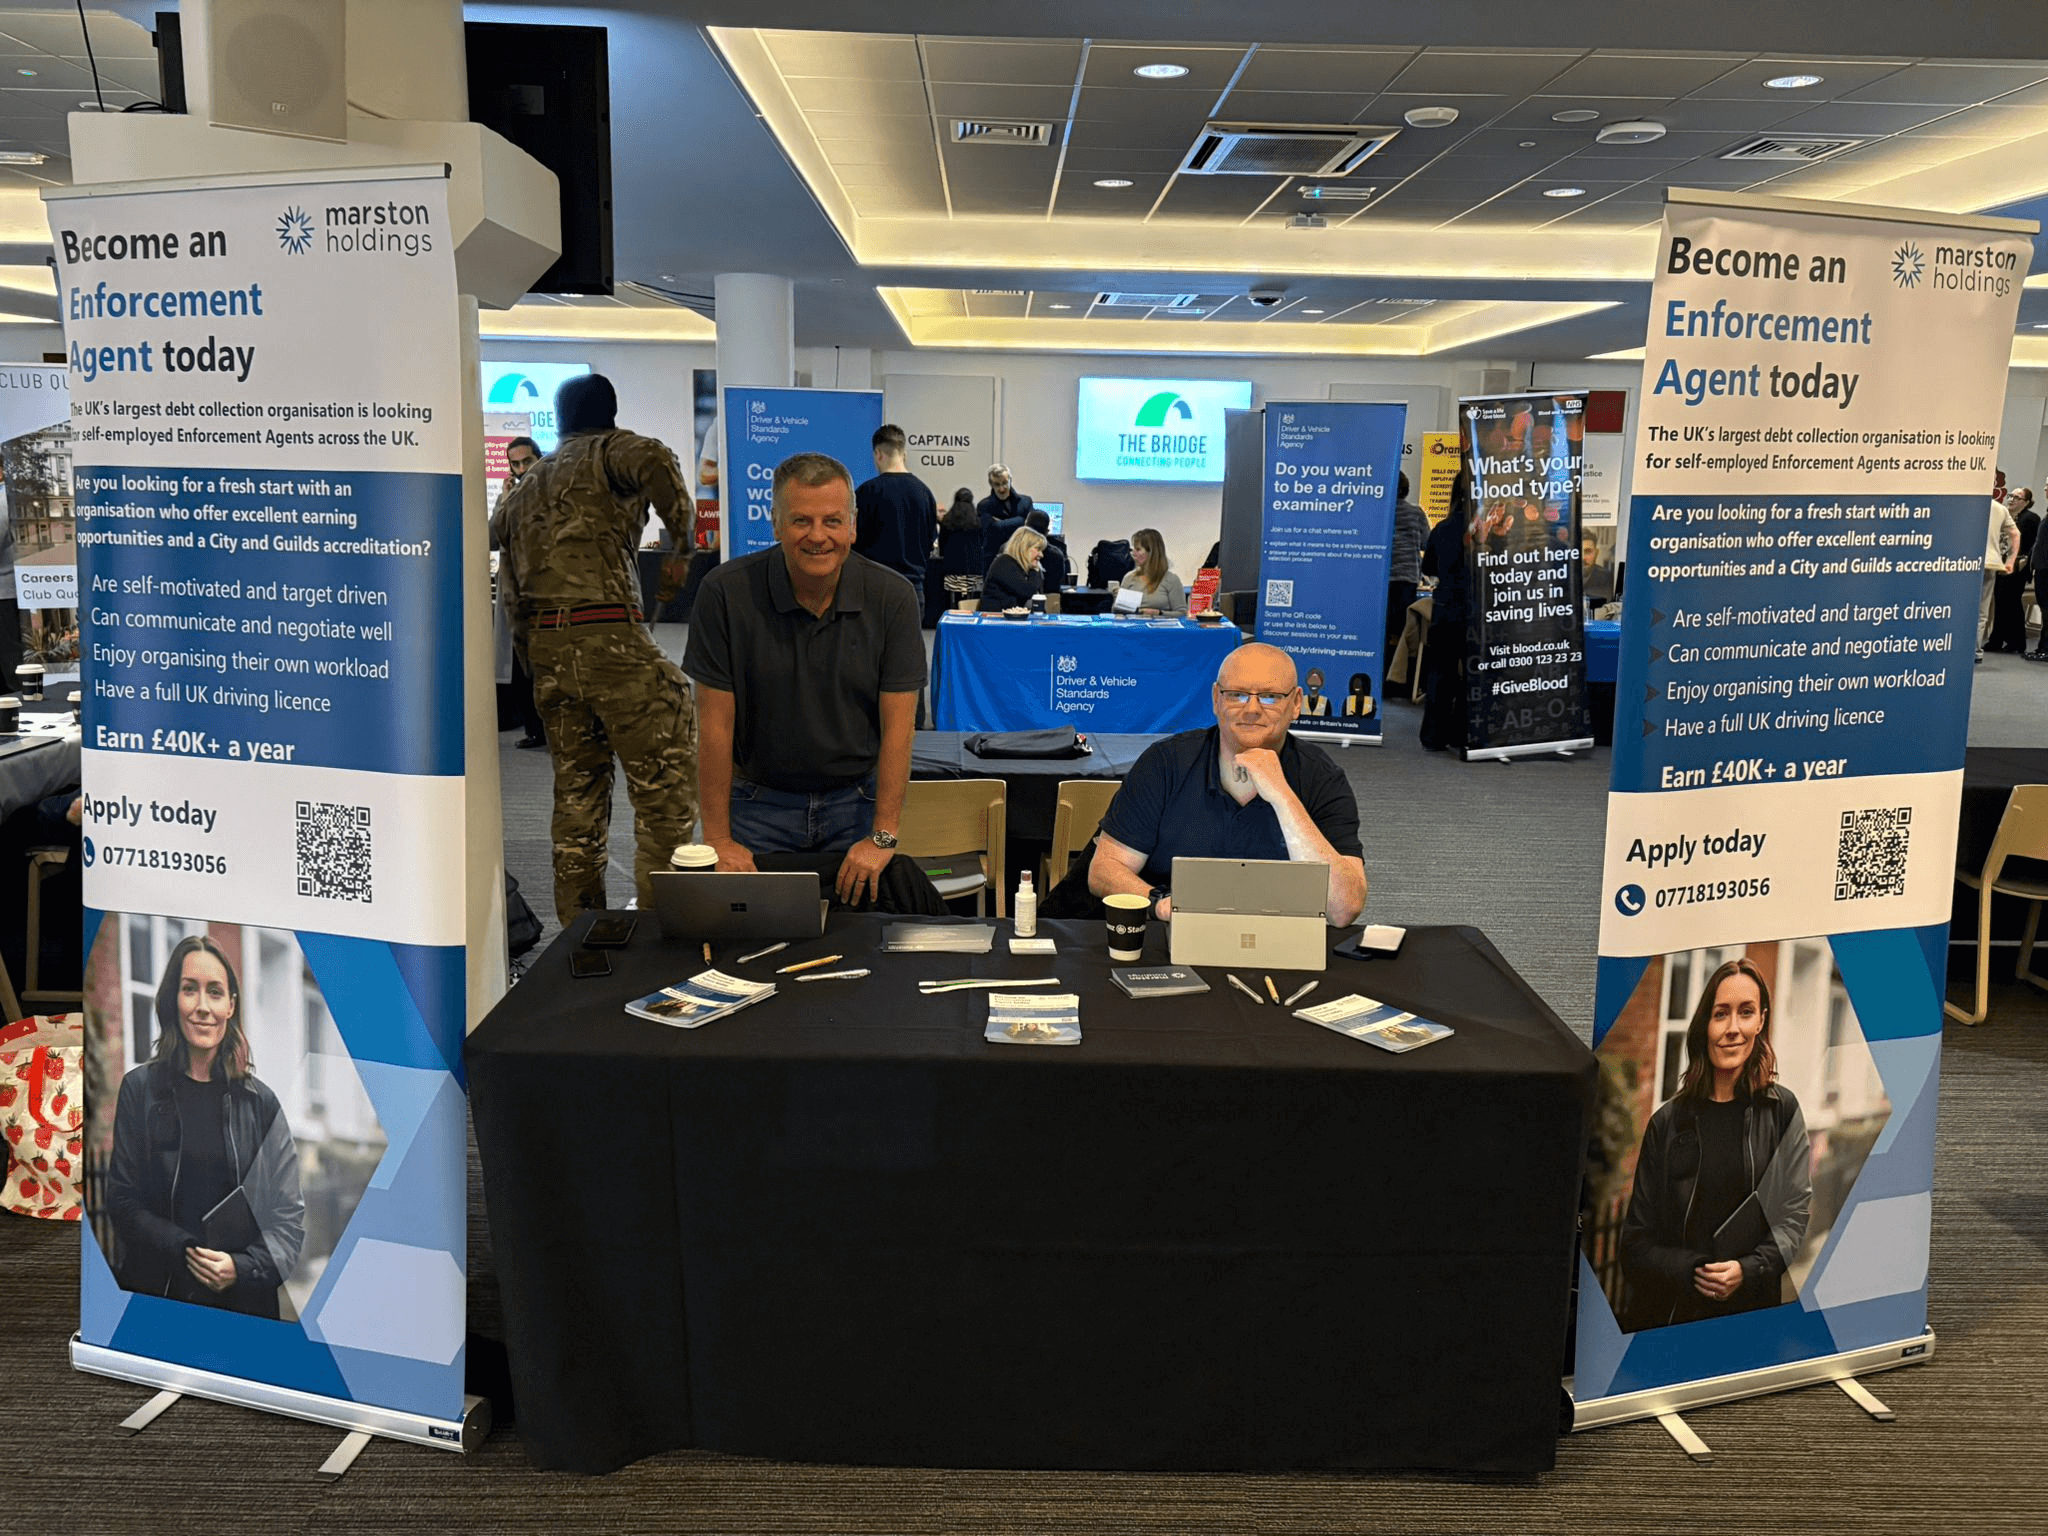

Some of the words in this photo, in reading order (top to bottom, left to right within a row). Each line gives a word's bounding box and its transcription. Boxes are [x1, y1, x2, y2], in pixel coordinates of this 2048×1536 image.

[326, 202, 428, 226] marston
[61, 230, 178, 264] Become
[190, 231, 226, 257] an
[327, 228, 432, 256] holdings
[1668, 237, 1799, 280] Become
[1809, 256, 1845, 283] an
[1936, 247, 2016, 270] marston
[1934, 268, 2010, 297] holdings
[71, 282, 262, 320] Enforcement
[1666, 299, 1872, 344] Enforcement
[70, 341, 152, 382] Agent
[163, 336, 254, 382] today
[0, 372, 42, 388] CLUB
[1653, 359, 1760, 406] Agent
[1770, 362, 1859, 409] today
[85, 401, 109, 415] UK's
[114, 400, 161, 419] largest
[166, 402, 195, 416] debt
[199, 402, 263, 416] collection
[268, 402, 353, 421] organisation
[358, 402, 368, 417] is
[373, 402, 432, 423] looking
[1566, 400, 1582, 408] NHS
[751, 415, 773, 424] Driver
[774, 416, 780, 424] &
[782, 416, 809, 426] Vehicle
[751, 425, 790, 434] Standards
[1307, 425, 1330, 433] Vehicle
[751, 434, 779, 444] Agency
[908, 434, 970, 446] CAPTAINS
[1118, 433, 1147, 452] THE
[1151, 434, 1207, 454] BRIDGE
[921, 455, 954, 466] CLUB
[1116, 456, 1171, 467] CONNECTING
[1174, 457, 1206, 468] PEOPLE
[1275, 462, 1297, 476] Do
[1301, 465, 1329, 478] you
[1334, 465, 1372, 477] want
[1468, 455, 1533, 476] What's
[1540, 456, 1582, 476] your
[1274, 481, 1289, 493] to
[1294, 480, 1313, 494] be
[1318, 484, 1326, 494] a
[1331, 481, 1384, 498] driving
[1471, 478, 1523, 499] blood
[1529, 475, 1582, 499] type?
[1273, 498, 1354, 512] examiner?
[1477, 550, 1508, 567] Find
[1513, 552, 1540, 564] out
[1545, 547, 1580, 562] here
[22, 573, 74, 583] Careers
[1489, 568, 1533, 586] today
[1537, 564, 1568, 581] and
[23, 589, 52, 600] Club
[1493, 587, 1521, 607] join
[1527, 588, 1544, 600] us
[1549, 584, 1563, 598] in
[1486, 605, 1533, 622] saving
[1539, 602, 1573, 618] lives
[1673, 610, 1701, 627] Are
[1706, 604, 1816, 626] self-motivated
[1820, 604, 1849, 622] and
[1854, 604, 1899, 625] target
[1904, 601, 1950, 619] driven
[1490, 645, 1510, 656] Visit
[1512, 640, 1570, 654] blood.co.uk
[1669, 644, 1699, 662] Can
[1704, 640, 1806, 660] communicate
[1812, 637, 1840, 656] and
[1845, 635, 1918, 658] negotiate
[1923, 633, 1952, 651] well
[1478, 662, 1489, 670] or
[1491, 659, 1506, 669] call
[1509, 657, 1533, 667] 0300
[1536, 655, 1552, 665] 123
[1555, 654, 1567, 663] 23
[1570, 652, 1582, 662] 23
[1056, 675, 1087, 686] Driver
[1090, 676, 1097, 686] &
[1100, 676, 1137, 686] Vehicle
[1492, 675, 1568, 695] #GiveBlood
[1668, 681, 1709, 704] Enjoy
[1714, 676, 1792, 699] organising
[1799, 674, 1834, 692] their
[1838, 676, 1868, 690] own
[1874, 668, 1945, 688] workload
[1056, 687, 1109, 699] Standards
[1056, 701, 1095, 713] Agency
[1662, 766, 1705, 788] Earn
[1712, 759, 1776, 783] £40K+
[1785, 762, 1796, 778] a
[1803, 759, 1847, 780] year
[84, 793, 142, 826] Apply
[150, 800, 216, 833] today
[1626, 835, 1697, 868] Apply
[1703, 828, 1766, 857] today
[103, 846, 226, 874] 07718193056
[1656, 878, 1769, 908] 07718193056
